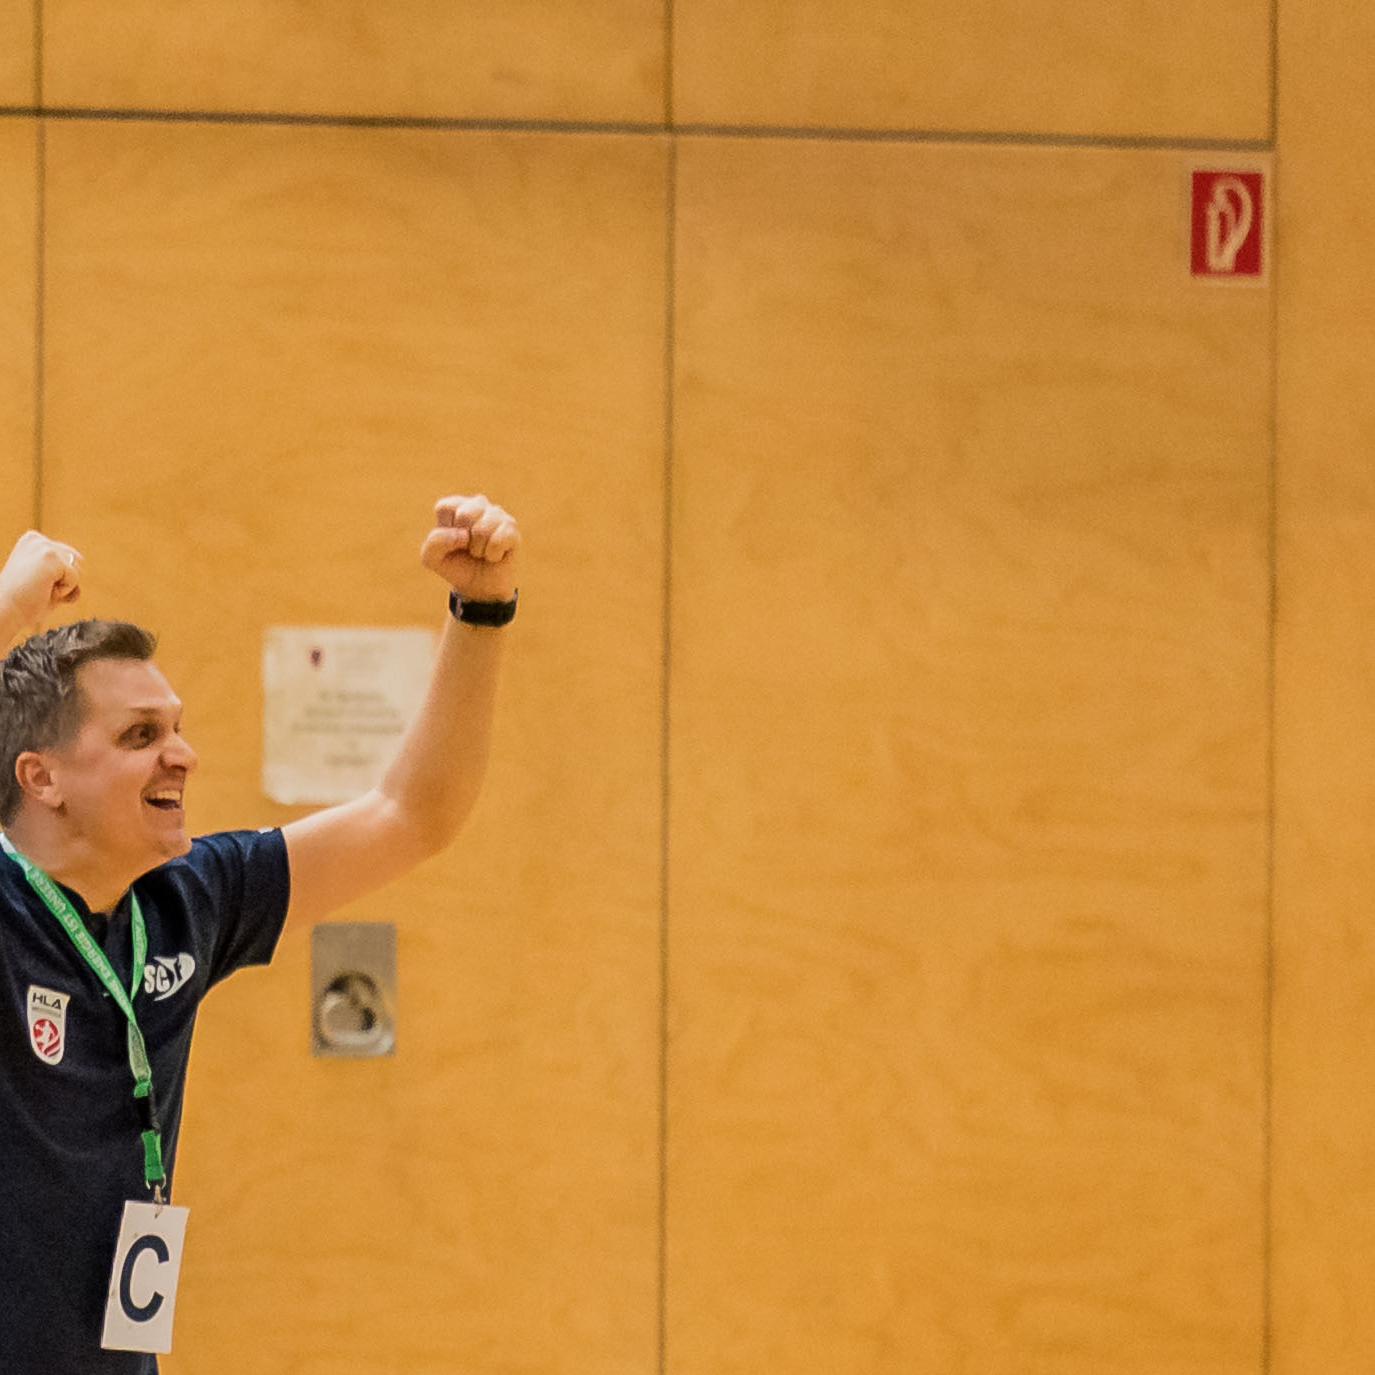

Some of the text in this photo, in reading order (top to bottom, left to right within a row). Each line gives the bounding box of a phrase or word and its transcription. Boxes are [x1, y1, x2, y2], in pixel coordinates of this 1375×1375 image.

[144, 954, 193, 999] SCF
[32, 992, 62, 1010] HLA
[119, 1234, 170, 1323] C
